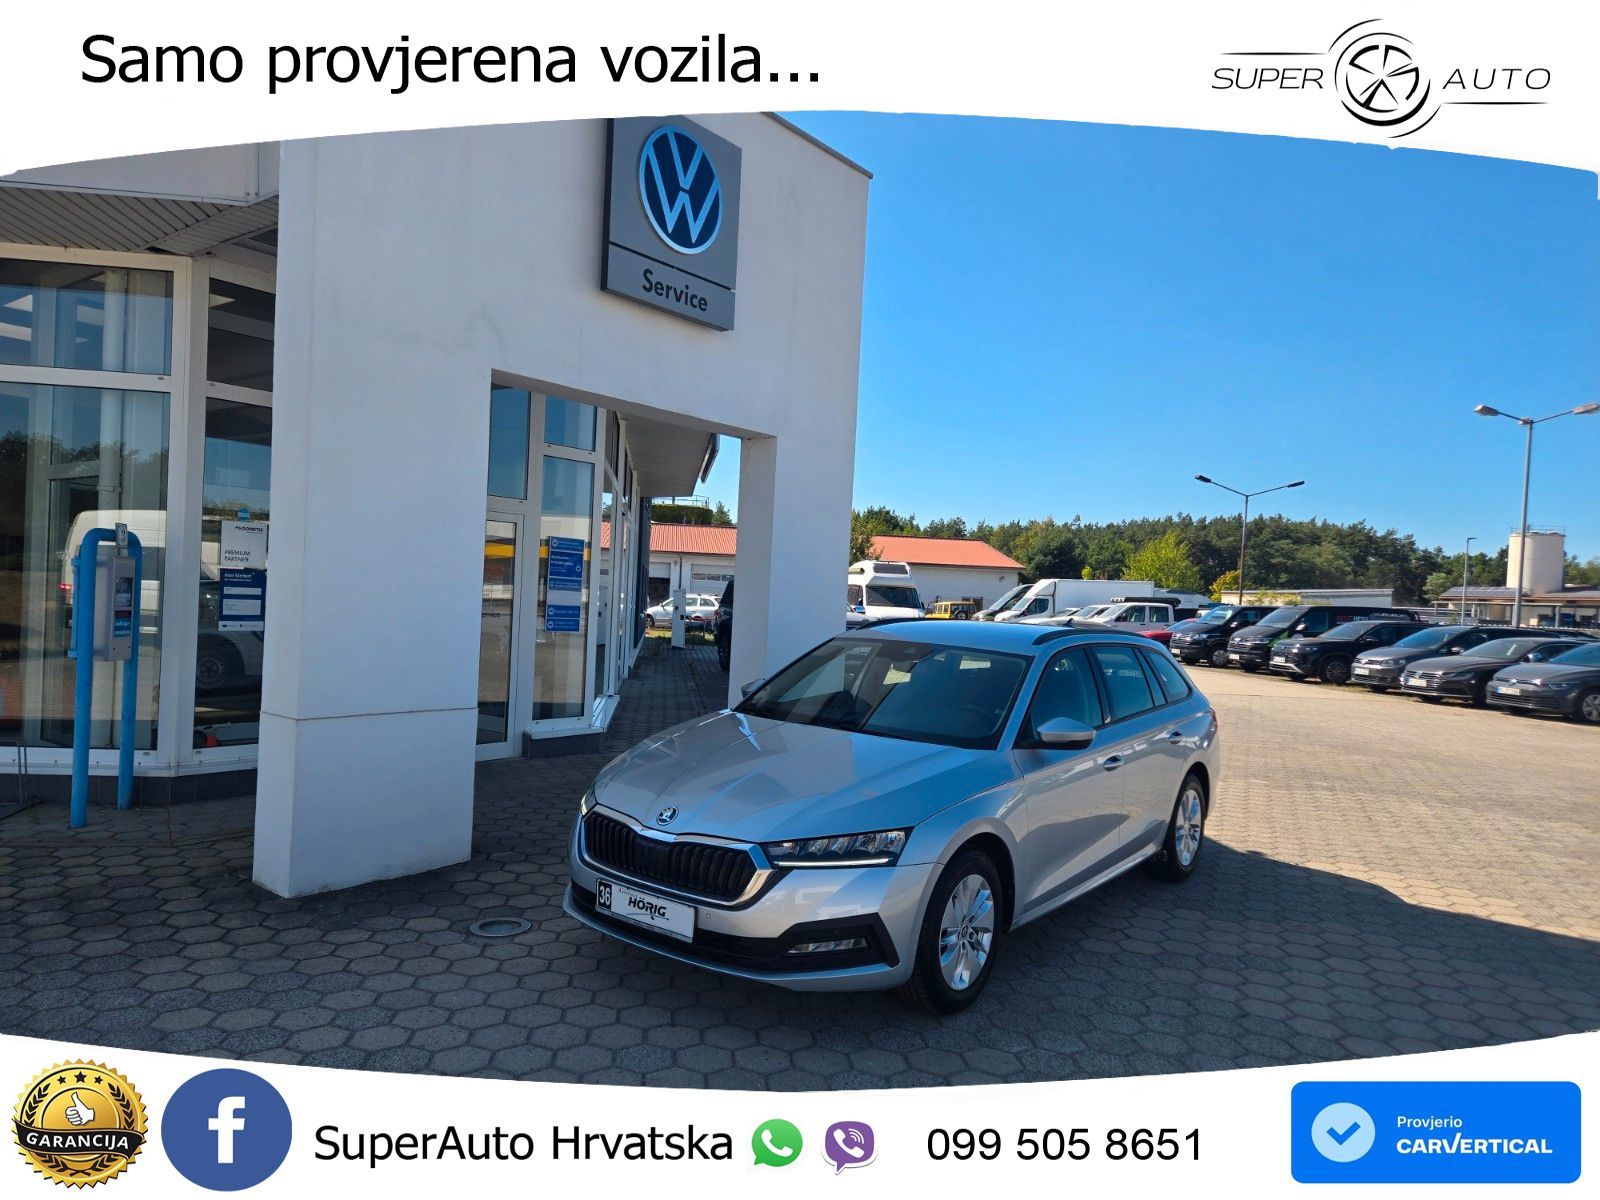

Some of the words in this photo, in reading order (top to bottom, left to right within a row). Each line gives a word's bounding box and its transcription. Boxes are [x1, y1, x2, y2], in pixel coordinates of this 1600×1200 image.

[642, 268, 709, 312] Service
[599, 885, 611, 906] 36
[628, 896, 667, 918] HÖRIG
